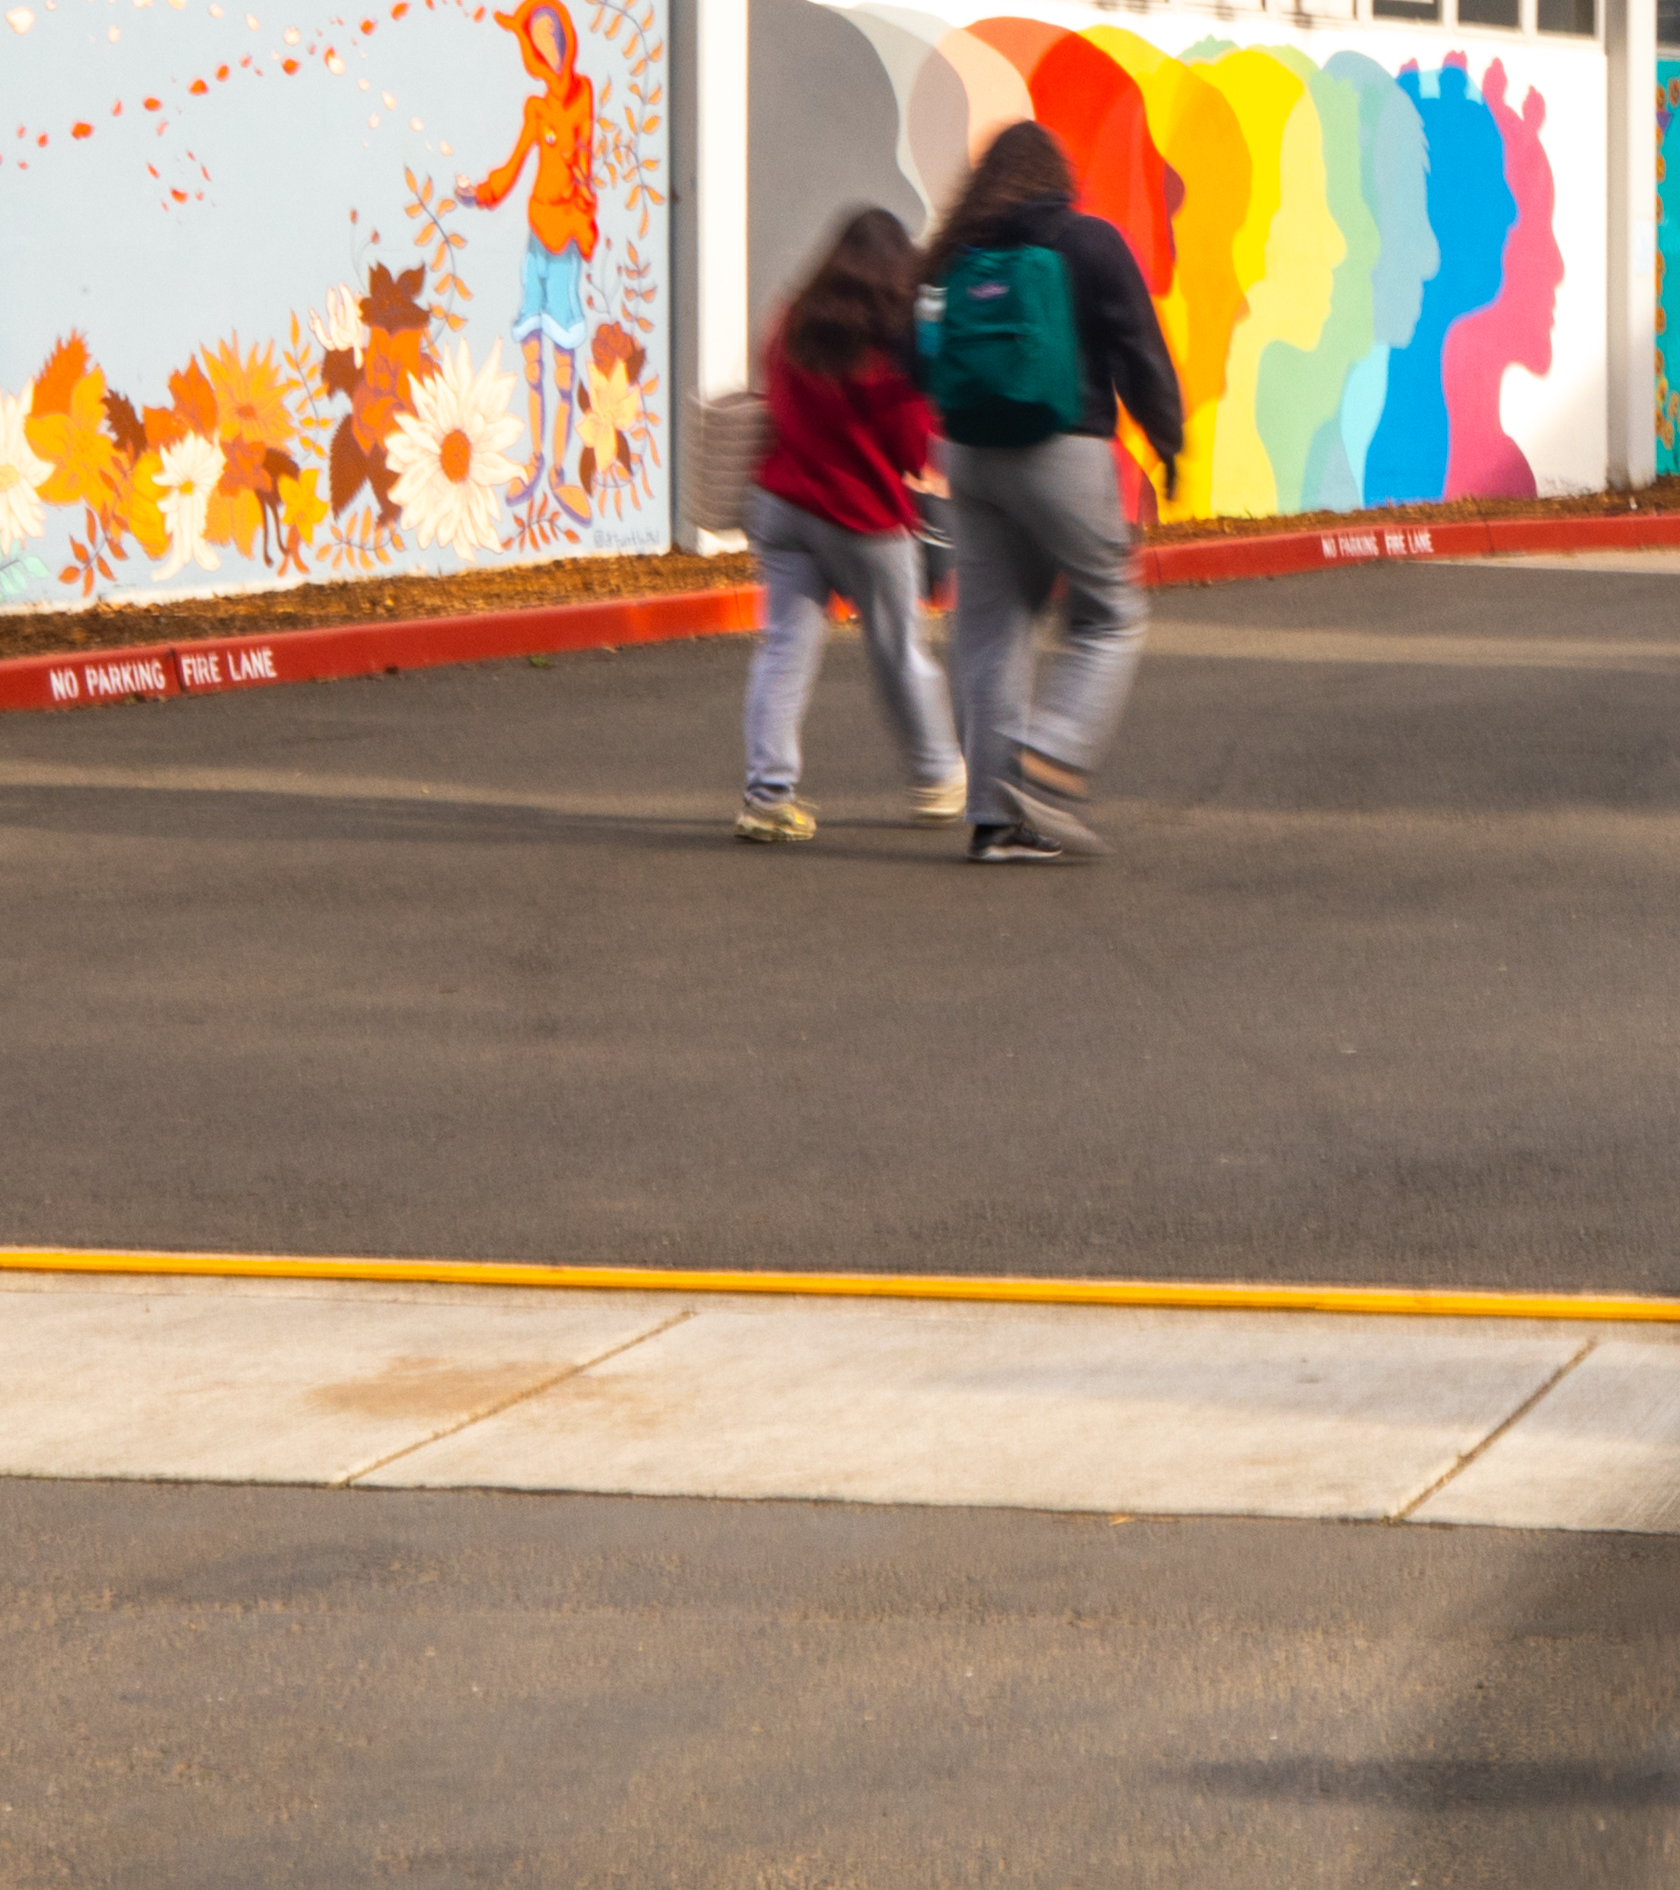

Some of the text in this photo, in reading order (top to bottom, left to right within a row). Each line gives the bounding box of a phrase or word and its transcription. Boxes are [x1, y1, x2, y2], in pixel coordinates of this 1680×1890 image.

[1338, 533, 1379, 557] PARKING
[1385, 530, 1407, 555] FIRE
[1407, 528, 1434, 553] LANE
[49, 646, 277, 700] NO PARKING FIRE LANE
